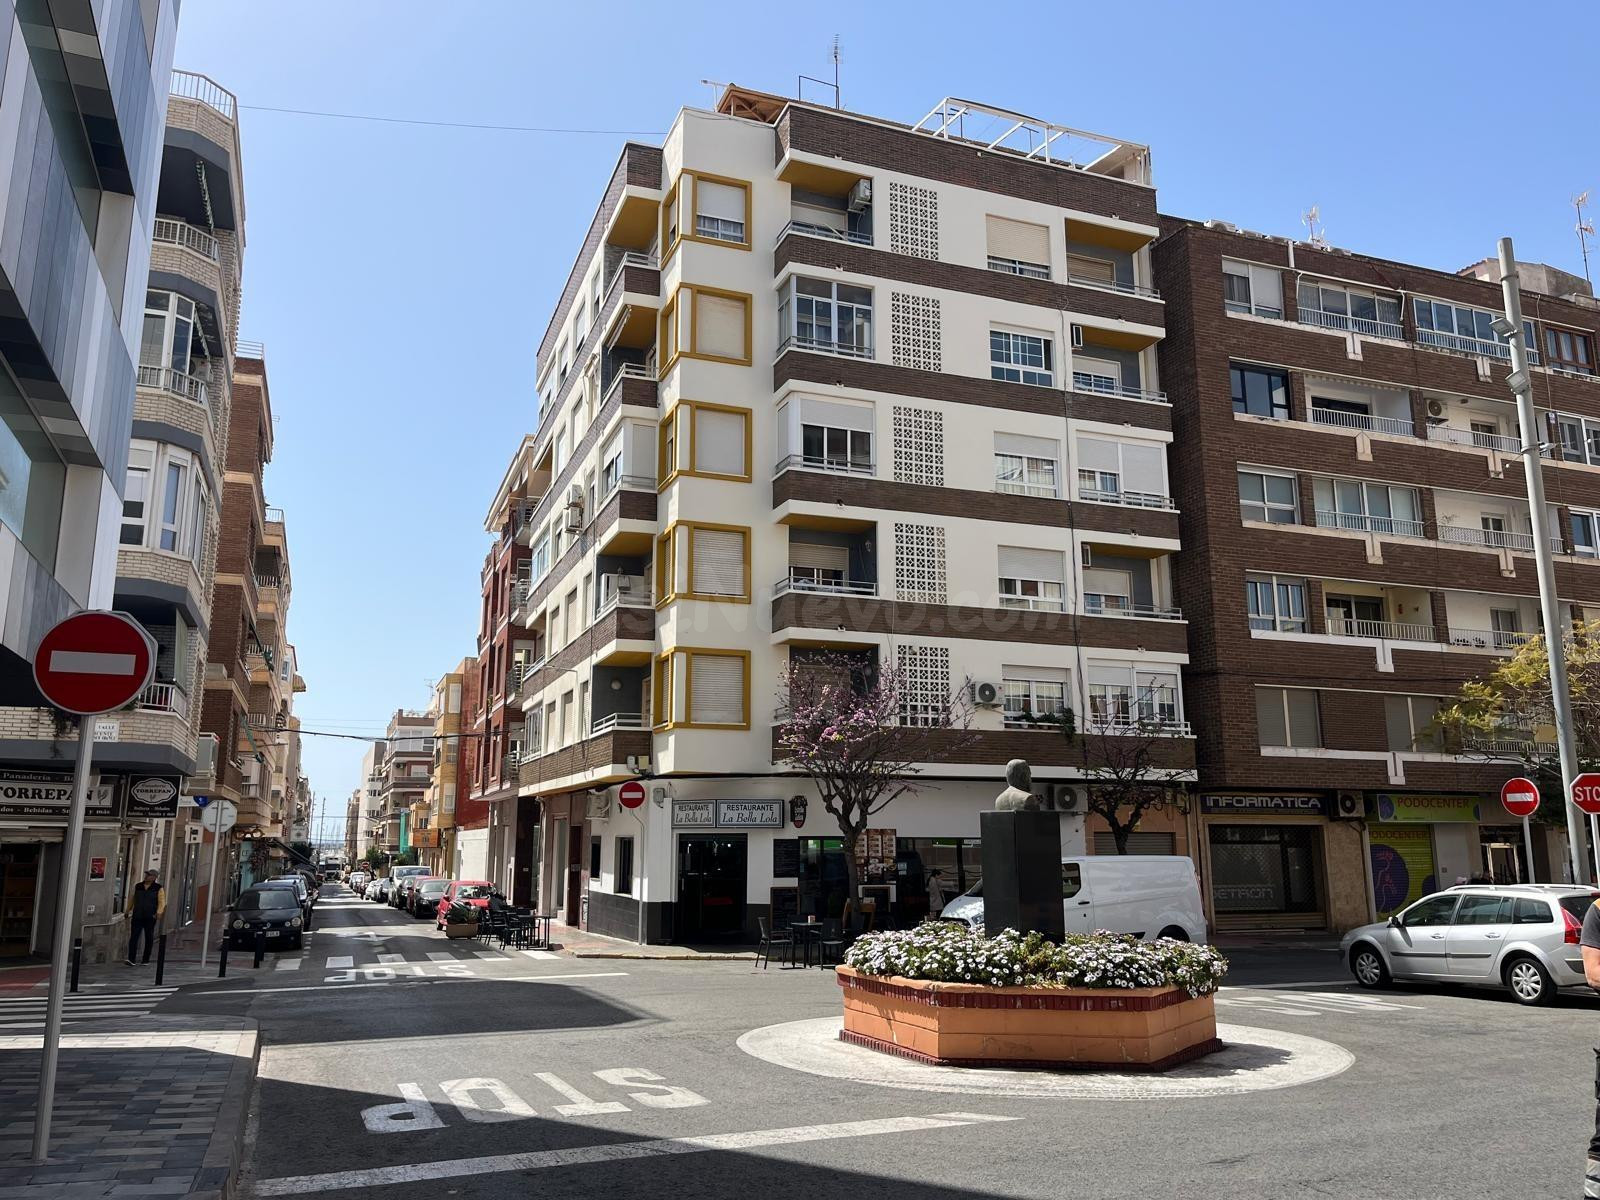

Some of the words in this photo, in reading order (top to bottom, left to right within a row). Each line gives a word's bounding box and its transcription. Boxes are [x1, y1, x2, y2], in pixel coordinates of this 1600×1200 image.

[0, 785, 93, 801] ORREPN
[1575, 783, 1600, 801] STO
[1206, 795, 1321, 808] INFORMATICA
[1397, 797, 1470, 809] PODOCENTER
[23, 806, 53, 814] Bebidas
[678, 804, 710, 812] RESTAURANTE
[675, 813, 683, 823] La
[684, 812, 698, 823] Bella
[699, 812, 712, 823] Lola
[722, 812, 733, 823] La
[736, 811, 757, 823] Bella
[760, 811, 778, 823] Lola
[359, 1067, 713, 1134] STOP
